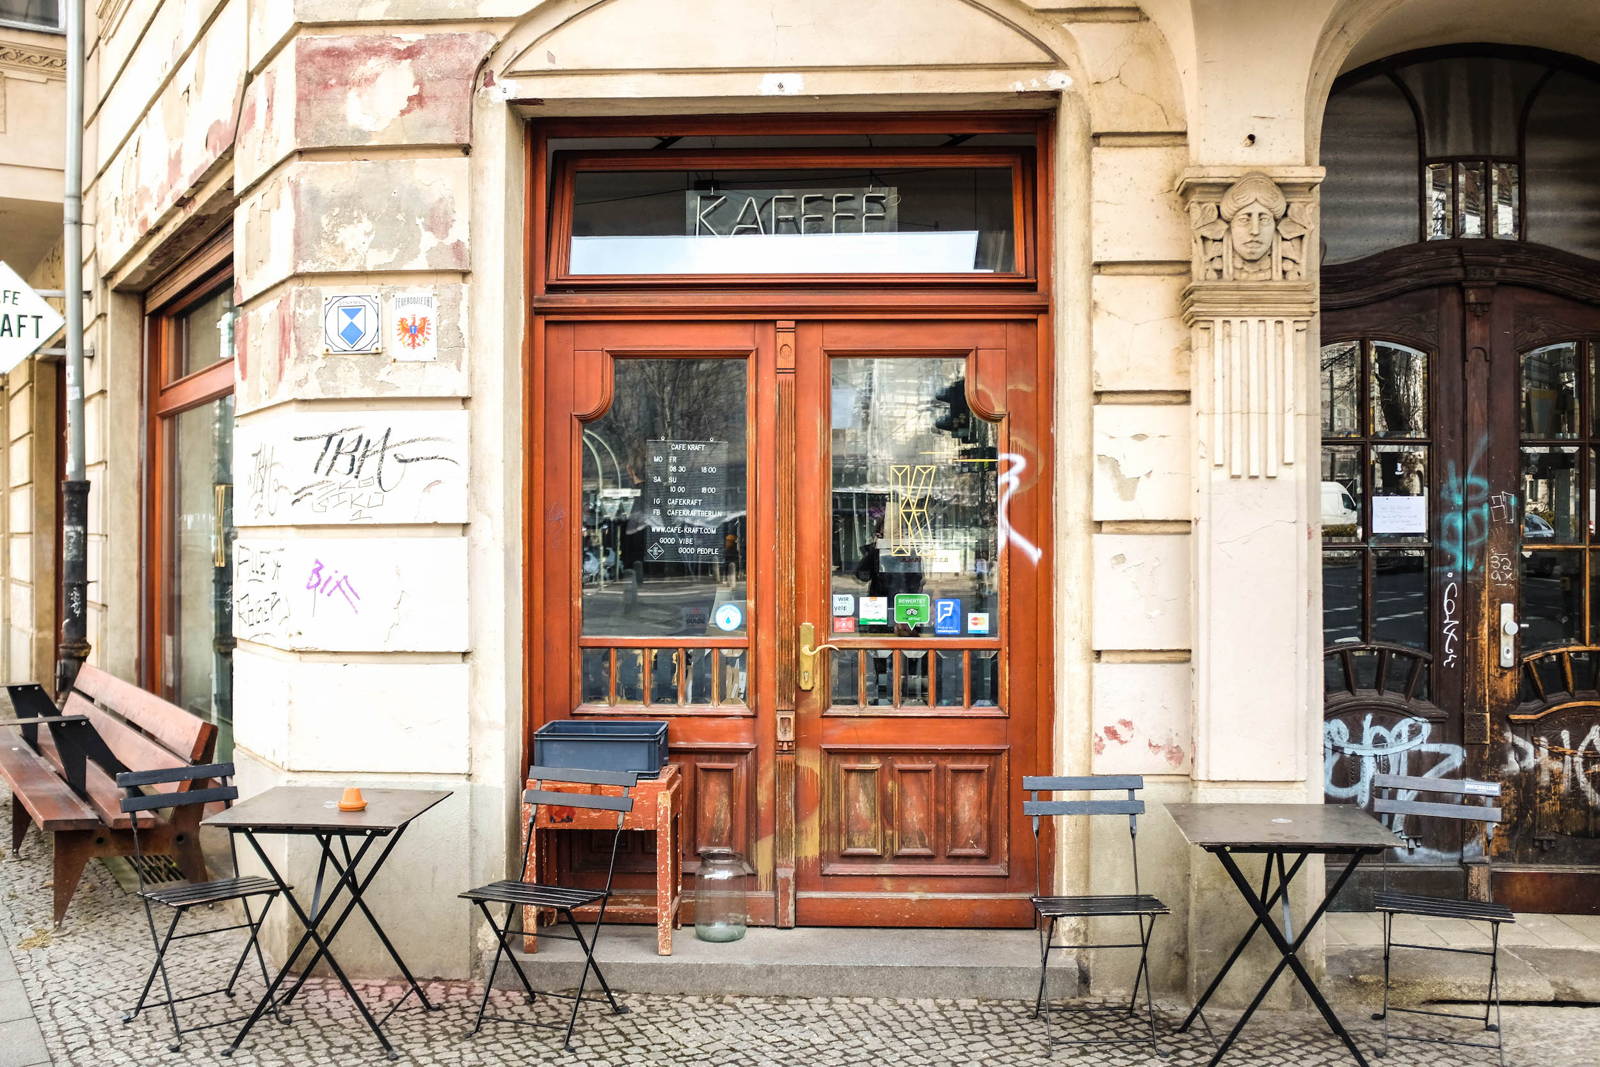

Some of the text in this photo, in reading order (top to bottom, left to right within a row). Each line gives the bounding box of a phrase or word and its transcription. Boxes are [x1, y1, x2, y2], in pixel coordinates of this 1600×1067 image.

[0, 289, 21, 306] FE
[670, 443, 706, 451] CAFE KRAFT
[667, 498, 703, 506] CAFEKRAFT
[652, 508, 723, 517] FB CAFEKRAFTBERLIN
[651, 526, 717, 535] WWW.CAFE-KRAFT.COM
[659, 537, 694, 545] GOOD VIBE
[677, 547, 720, 556] GOOD PEOPLE
